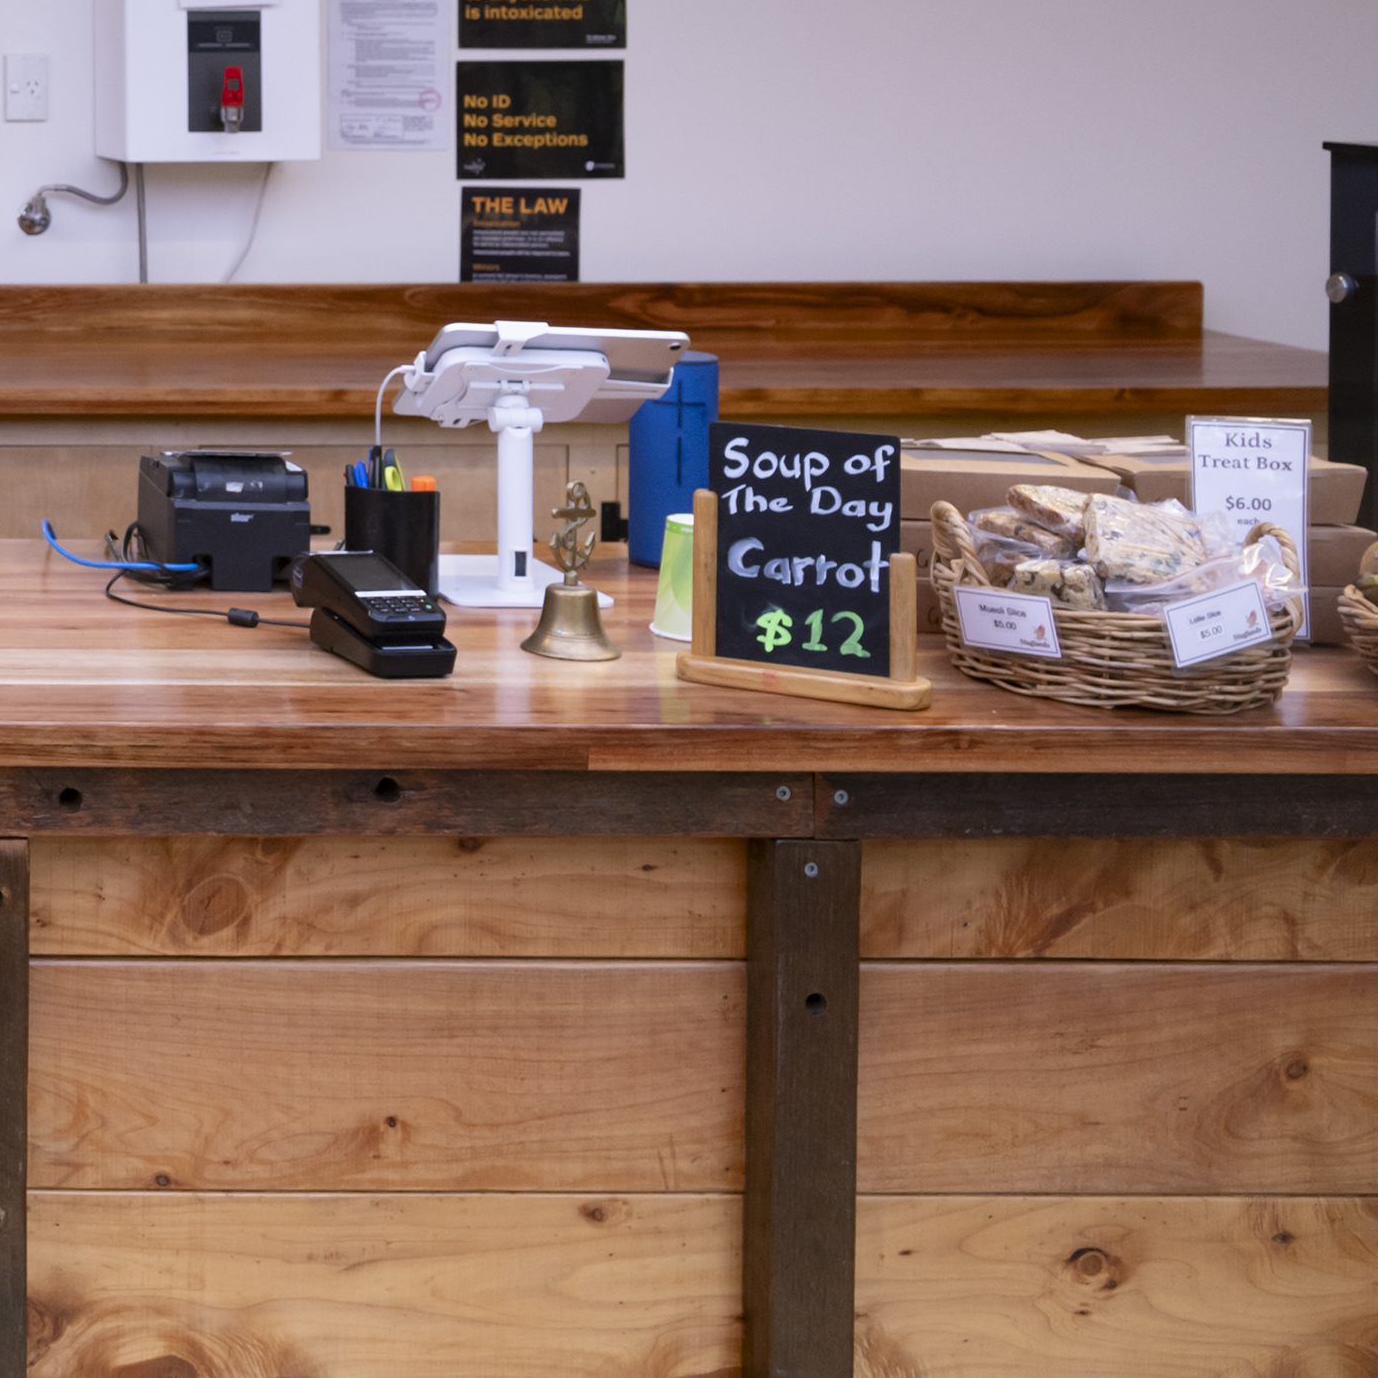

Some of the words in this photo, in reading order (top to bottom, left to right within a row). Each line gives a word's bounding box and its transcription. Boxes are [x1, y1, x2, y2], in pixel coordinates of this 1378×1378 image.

[464, 5, 481, 20] is
[484, 4, 583, 20] intoxicated
[463, 94, 488, 108] No
[492, 94, 511, 108] ID
[463, 114, 488, 128] No
[492, 113, 557, 128] Service
[463, 133, 488, 147] No
[492, 132, 589, 149] Exceptions
[471, 196, 514, 213] THE
[519, 197, 568, 215] LAW
[1225, 432, 1272, 449] Kids
[723, 436, 829, 492] Soup
[844, 444, 894, 483] of
[1198, 454, 1250, 469] Treat
[1256, 457, 1293, 471] Box
[721, 484, 793, 515] The
[810, 486, 893, 532] Day
[1226, 495, 1272, 511] $6.00
[727, 537, 890, 593] Carrot
[755, 602, 871, 658] $12
